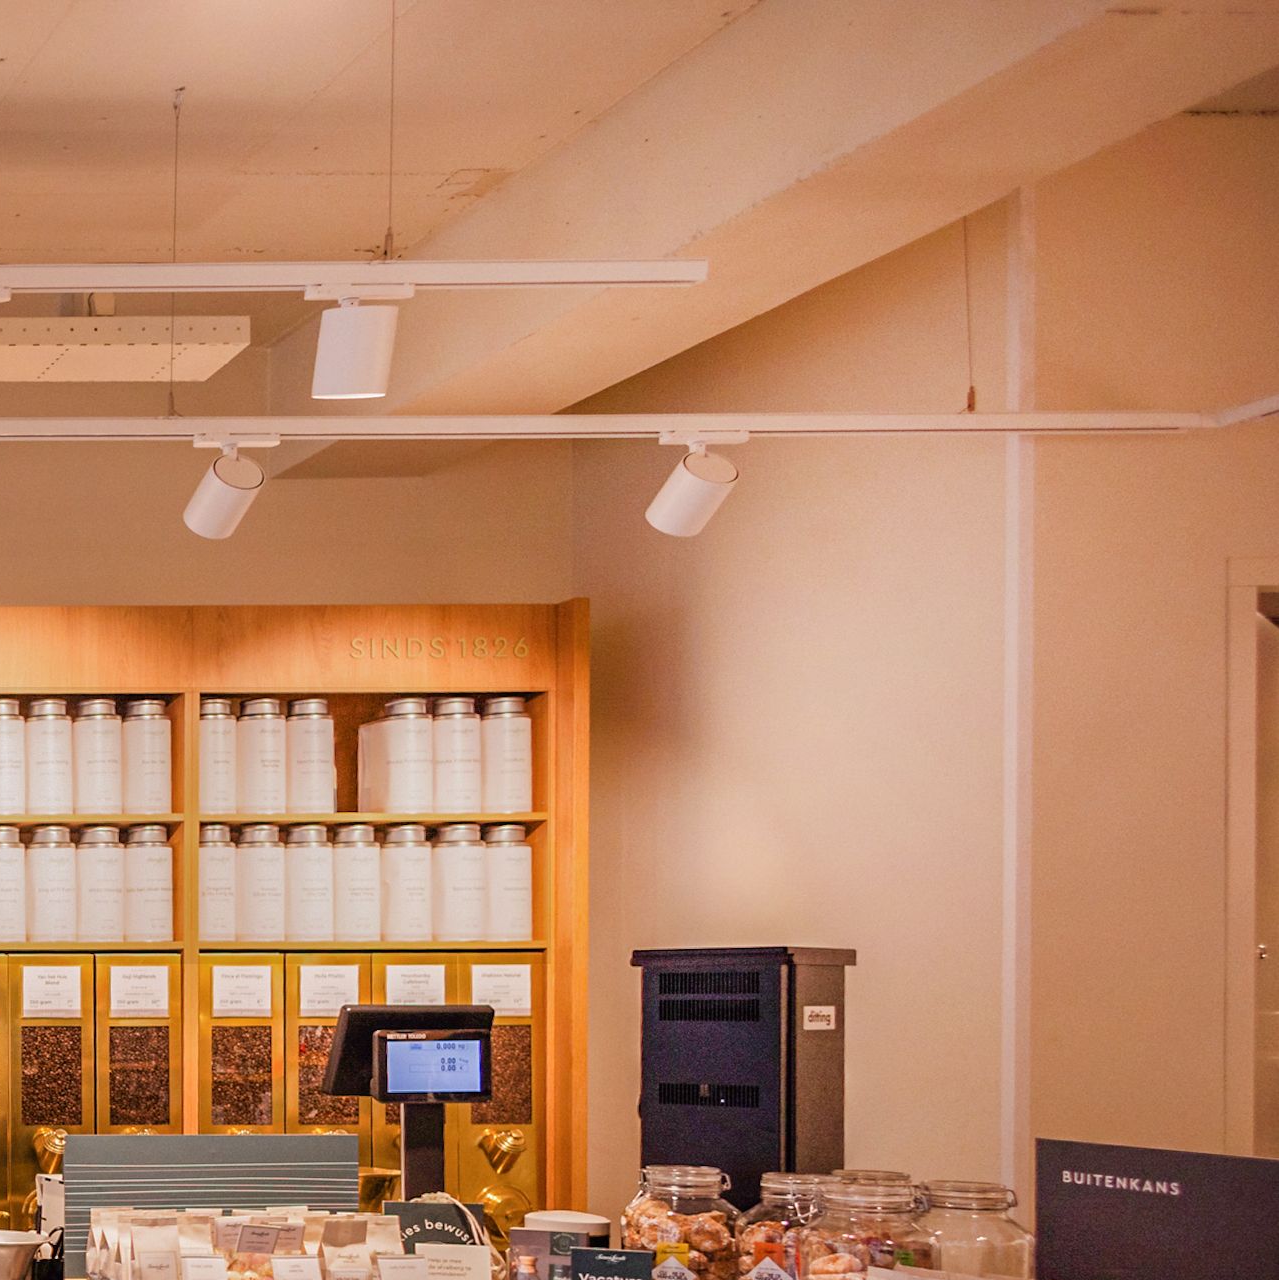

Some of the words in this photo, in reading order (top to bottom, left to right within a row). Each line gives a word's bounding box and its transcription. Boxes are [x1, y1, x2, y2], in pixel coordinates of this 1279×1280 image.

[349, 637, 446, 659] SINDS
[457, 636, 530, 659] 1826
[1062, 1170, 1181, 1196] BUITENKANS
